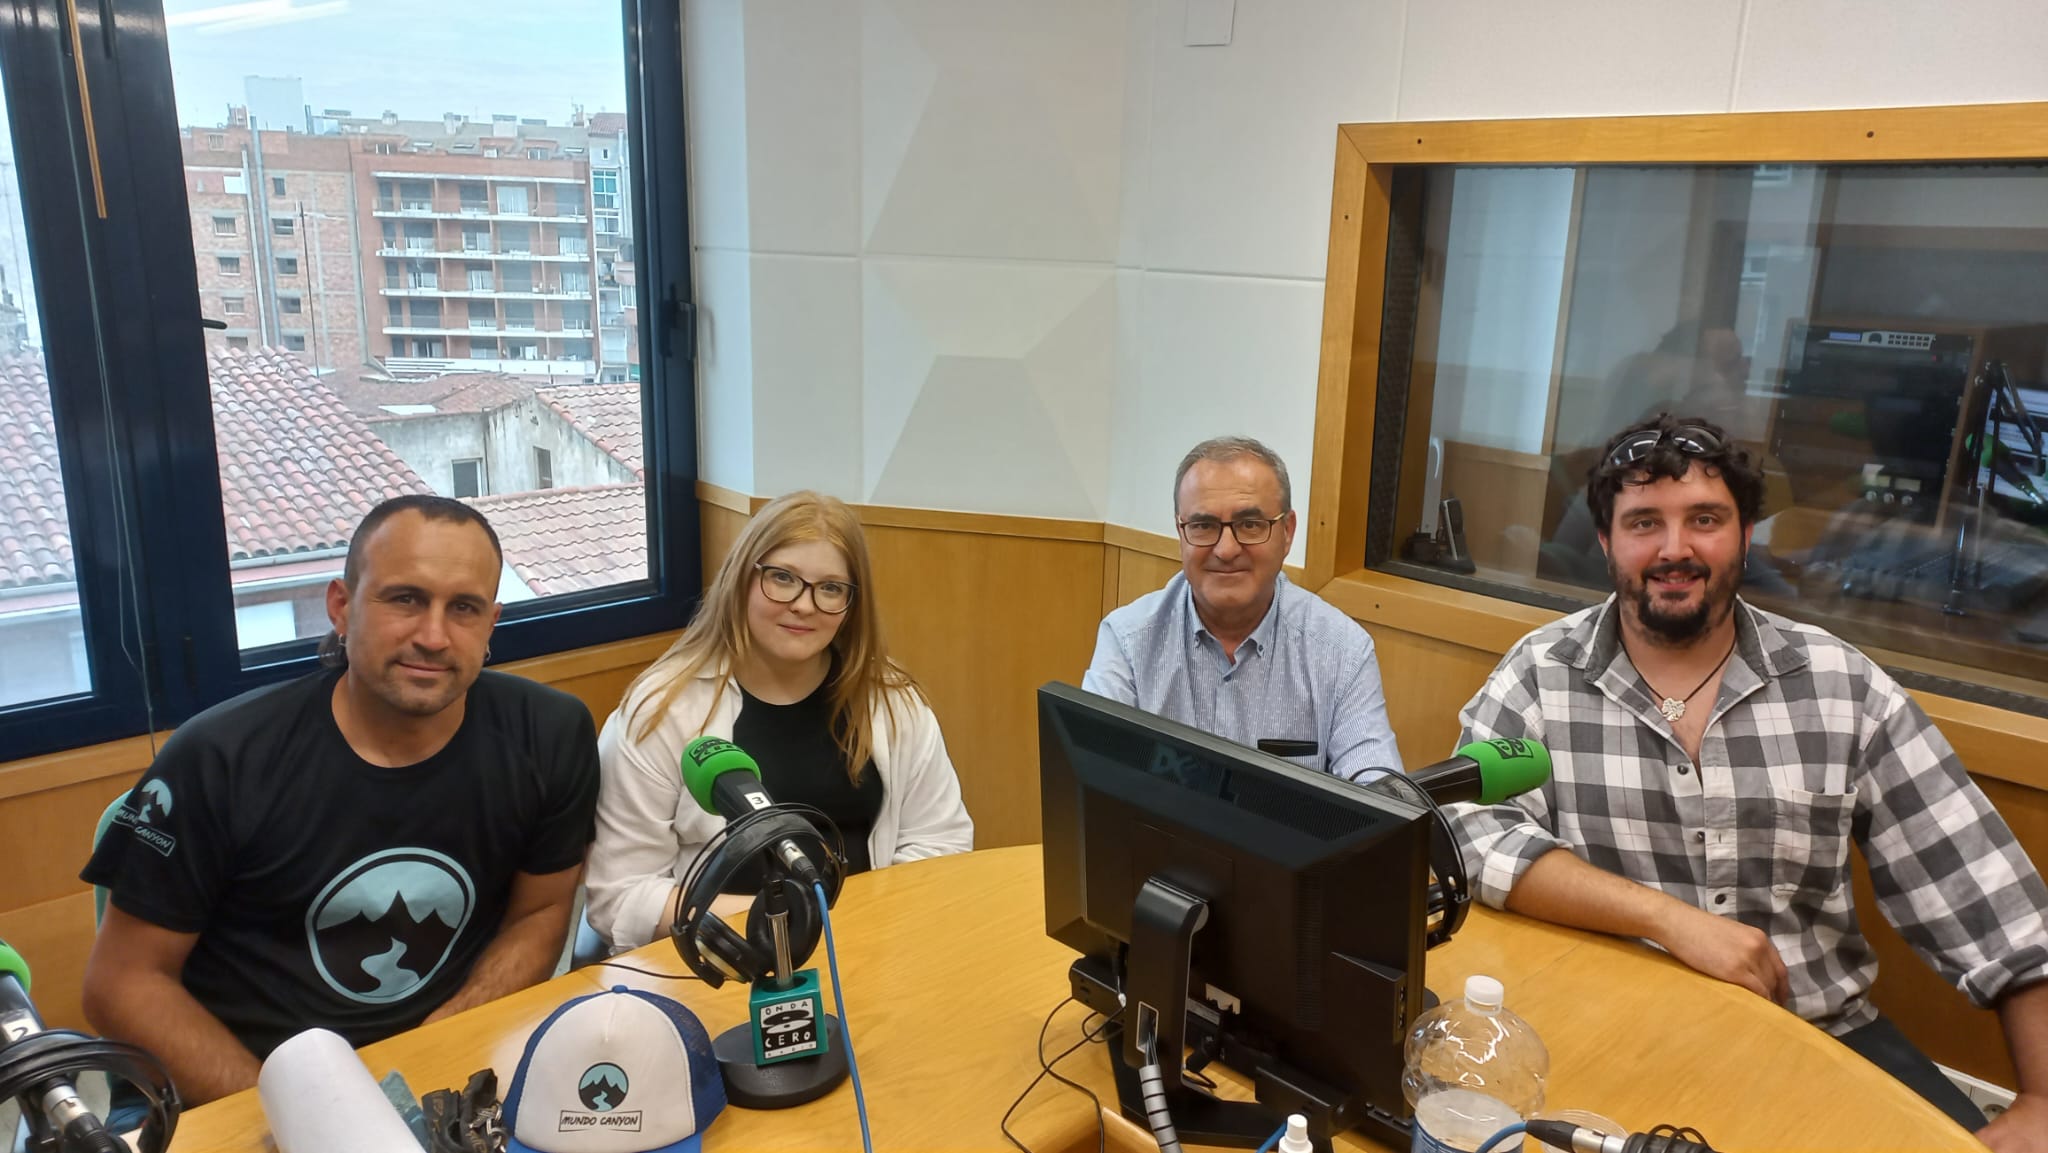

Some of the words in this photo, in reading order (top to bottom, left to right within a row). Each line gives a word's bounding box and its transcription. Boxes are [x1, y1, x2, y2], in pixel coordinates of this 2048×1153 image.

[751, 796, 765, 805] 3
[135, 826, 172, 848] CANYON
[765, 1000, 808, 1016] ONDA
[764, 1031, 812, 1048] CERO
[561, 1115, 598, 1126] MUNDO
[600, 1115, 639, 1127] CANYON
